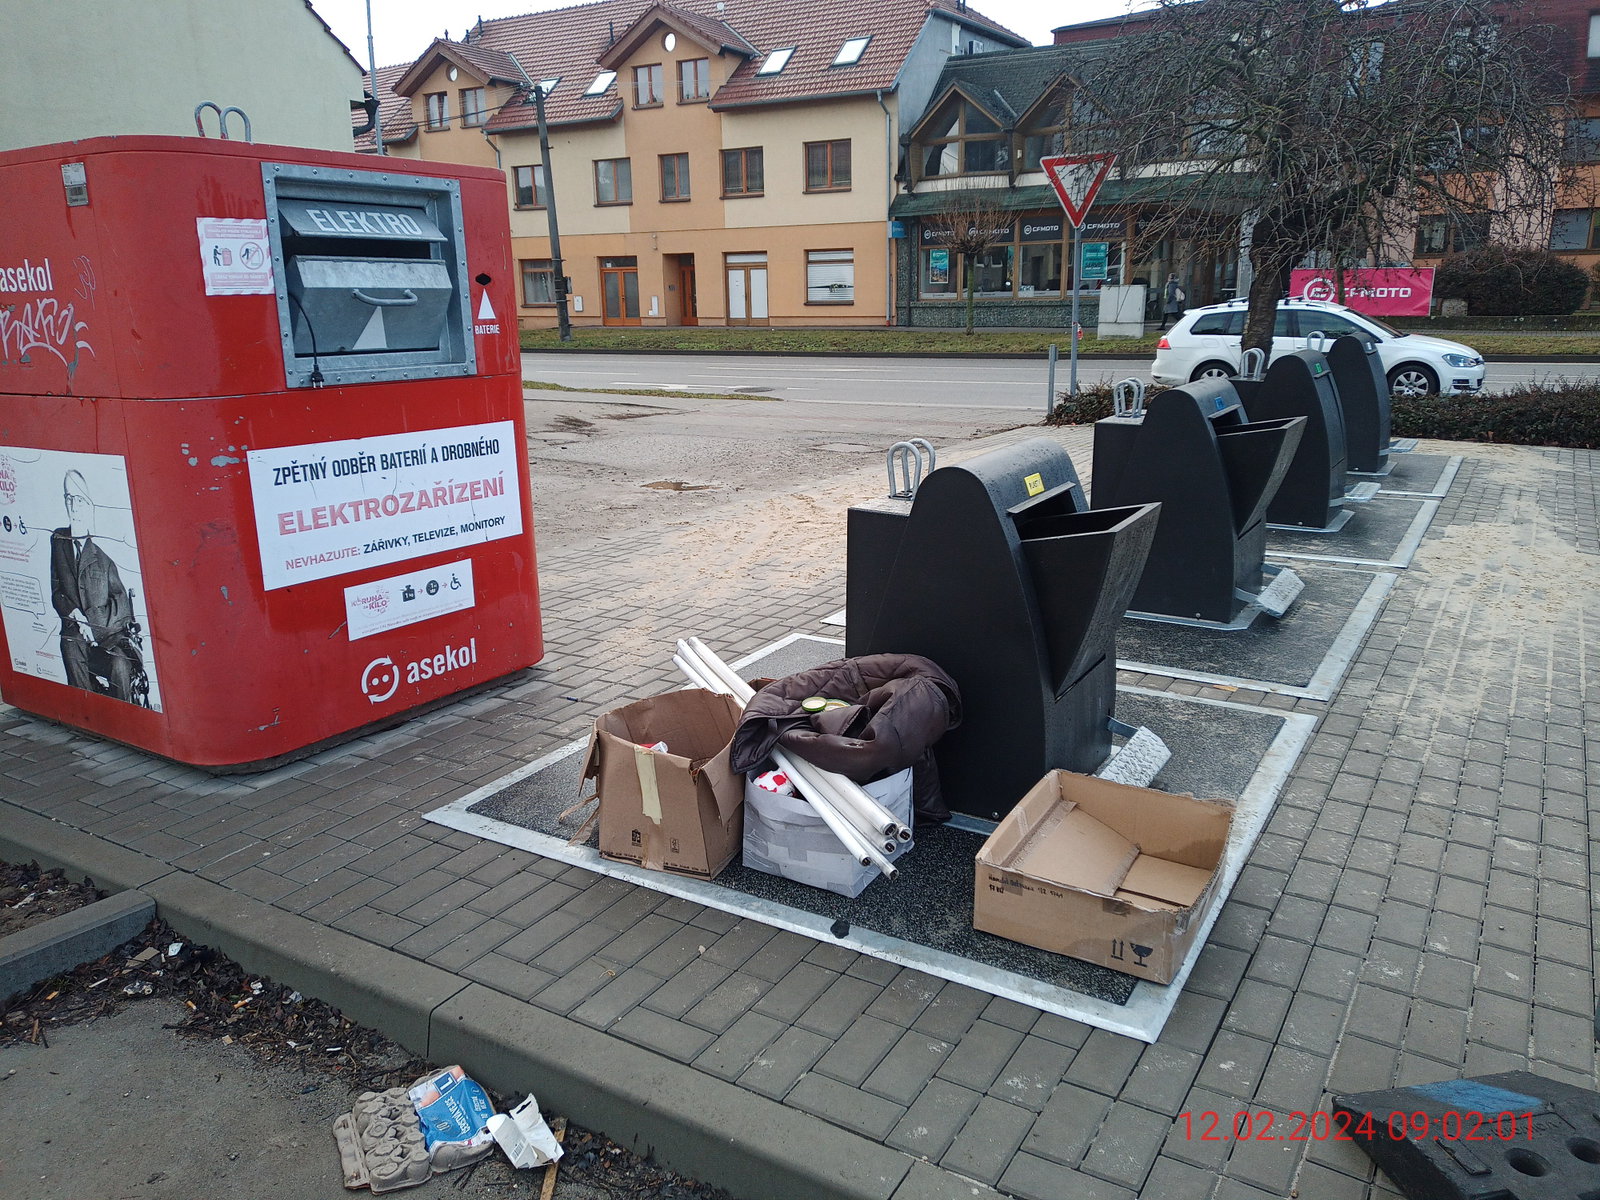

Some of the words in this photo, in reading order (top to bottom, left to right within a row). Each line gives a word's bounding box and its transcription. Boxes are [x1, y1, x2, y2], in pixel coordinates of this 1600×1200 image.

[306, 208, 422, 235] ELEKTRO
[0, 258, 53, 292] asekol
[474, 324, 500, 335] BATERIE
[273, 456, 327, 486] ZPĚTNÝ
[332, 452, 376, 478] ODBĚR
[380, 444, 427, 471] BATERIÍ
[431, 447, 438, 463] A
[441, 436, 500, 462] DROBNÉHO
[277, 471, 505, 535] ELEKTROZAŘÍZENÍ
[285, 547, 361, 570] NEVHAZUJTE:
[363, 535, 411, 554] ZÁŘIVKY,
[412, 525, 459, 544] TELEVIZE,
[460, 515, 506, 534] MONITORY
[369, 600, 387, 610] KILO
[406, 638, 477, 684] asekol
